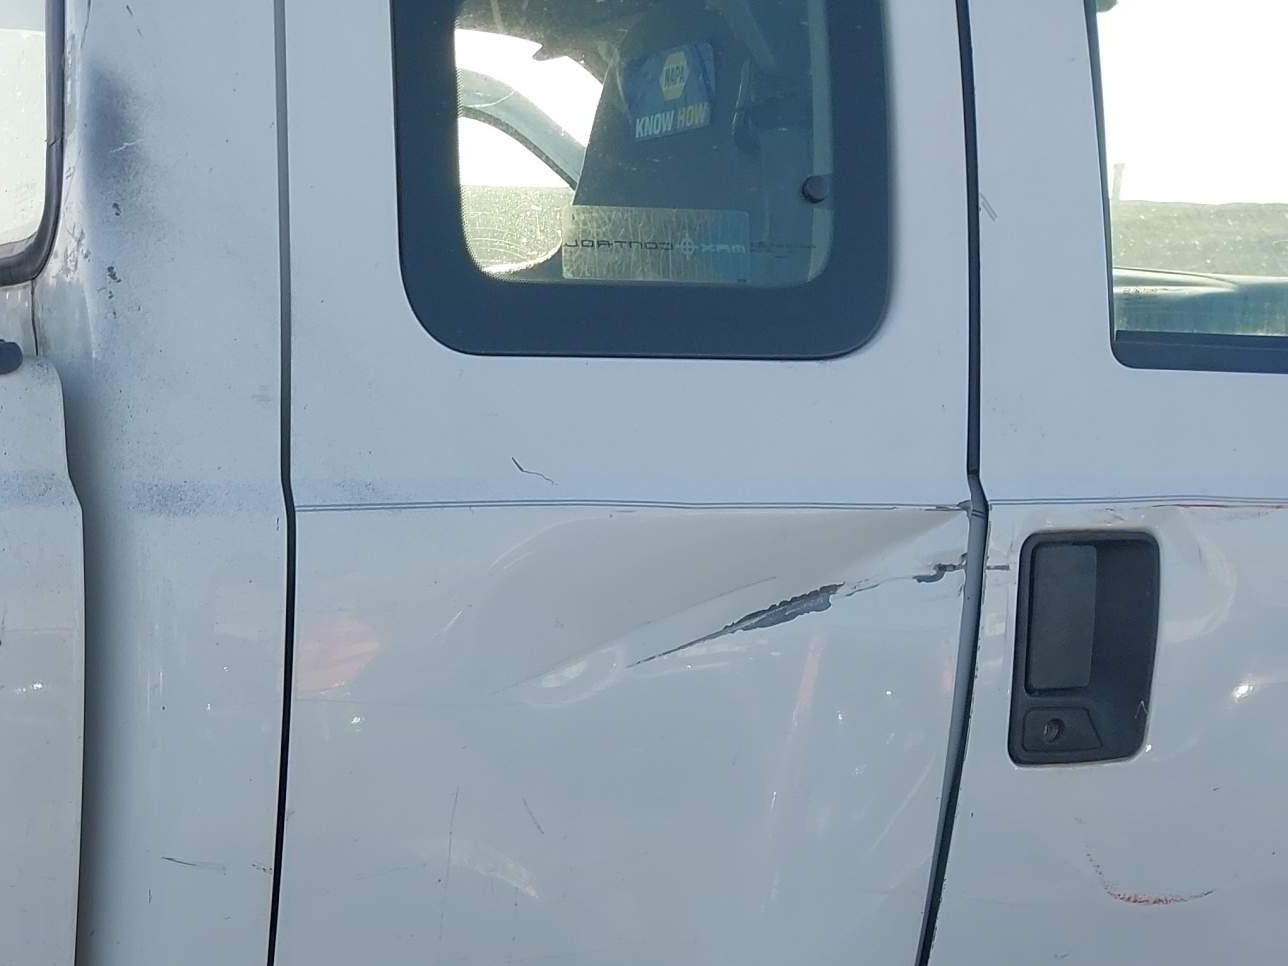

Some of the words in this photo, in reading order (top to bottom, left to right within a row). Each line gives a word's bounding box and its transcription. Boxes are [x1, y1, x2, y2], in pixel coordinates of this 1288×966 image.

[663, 64, 686, 89] NAPA
[635, 110, 674, 138] KNOW
[677, 103, 707, 129] HOW
